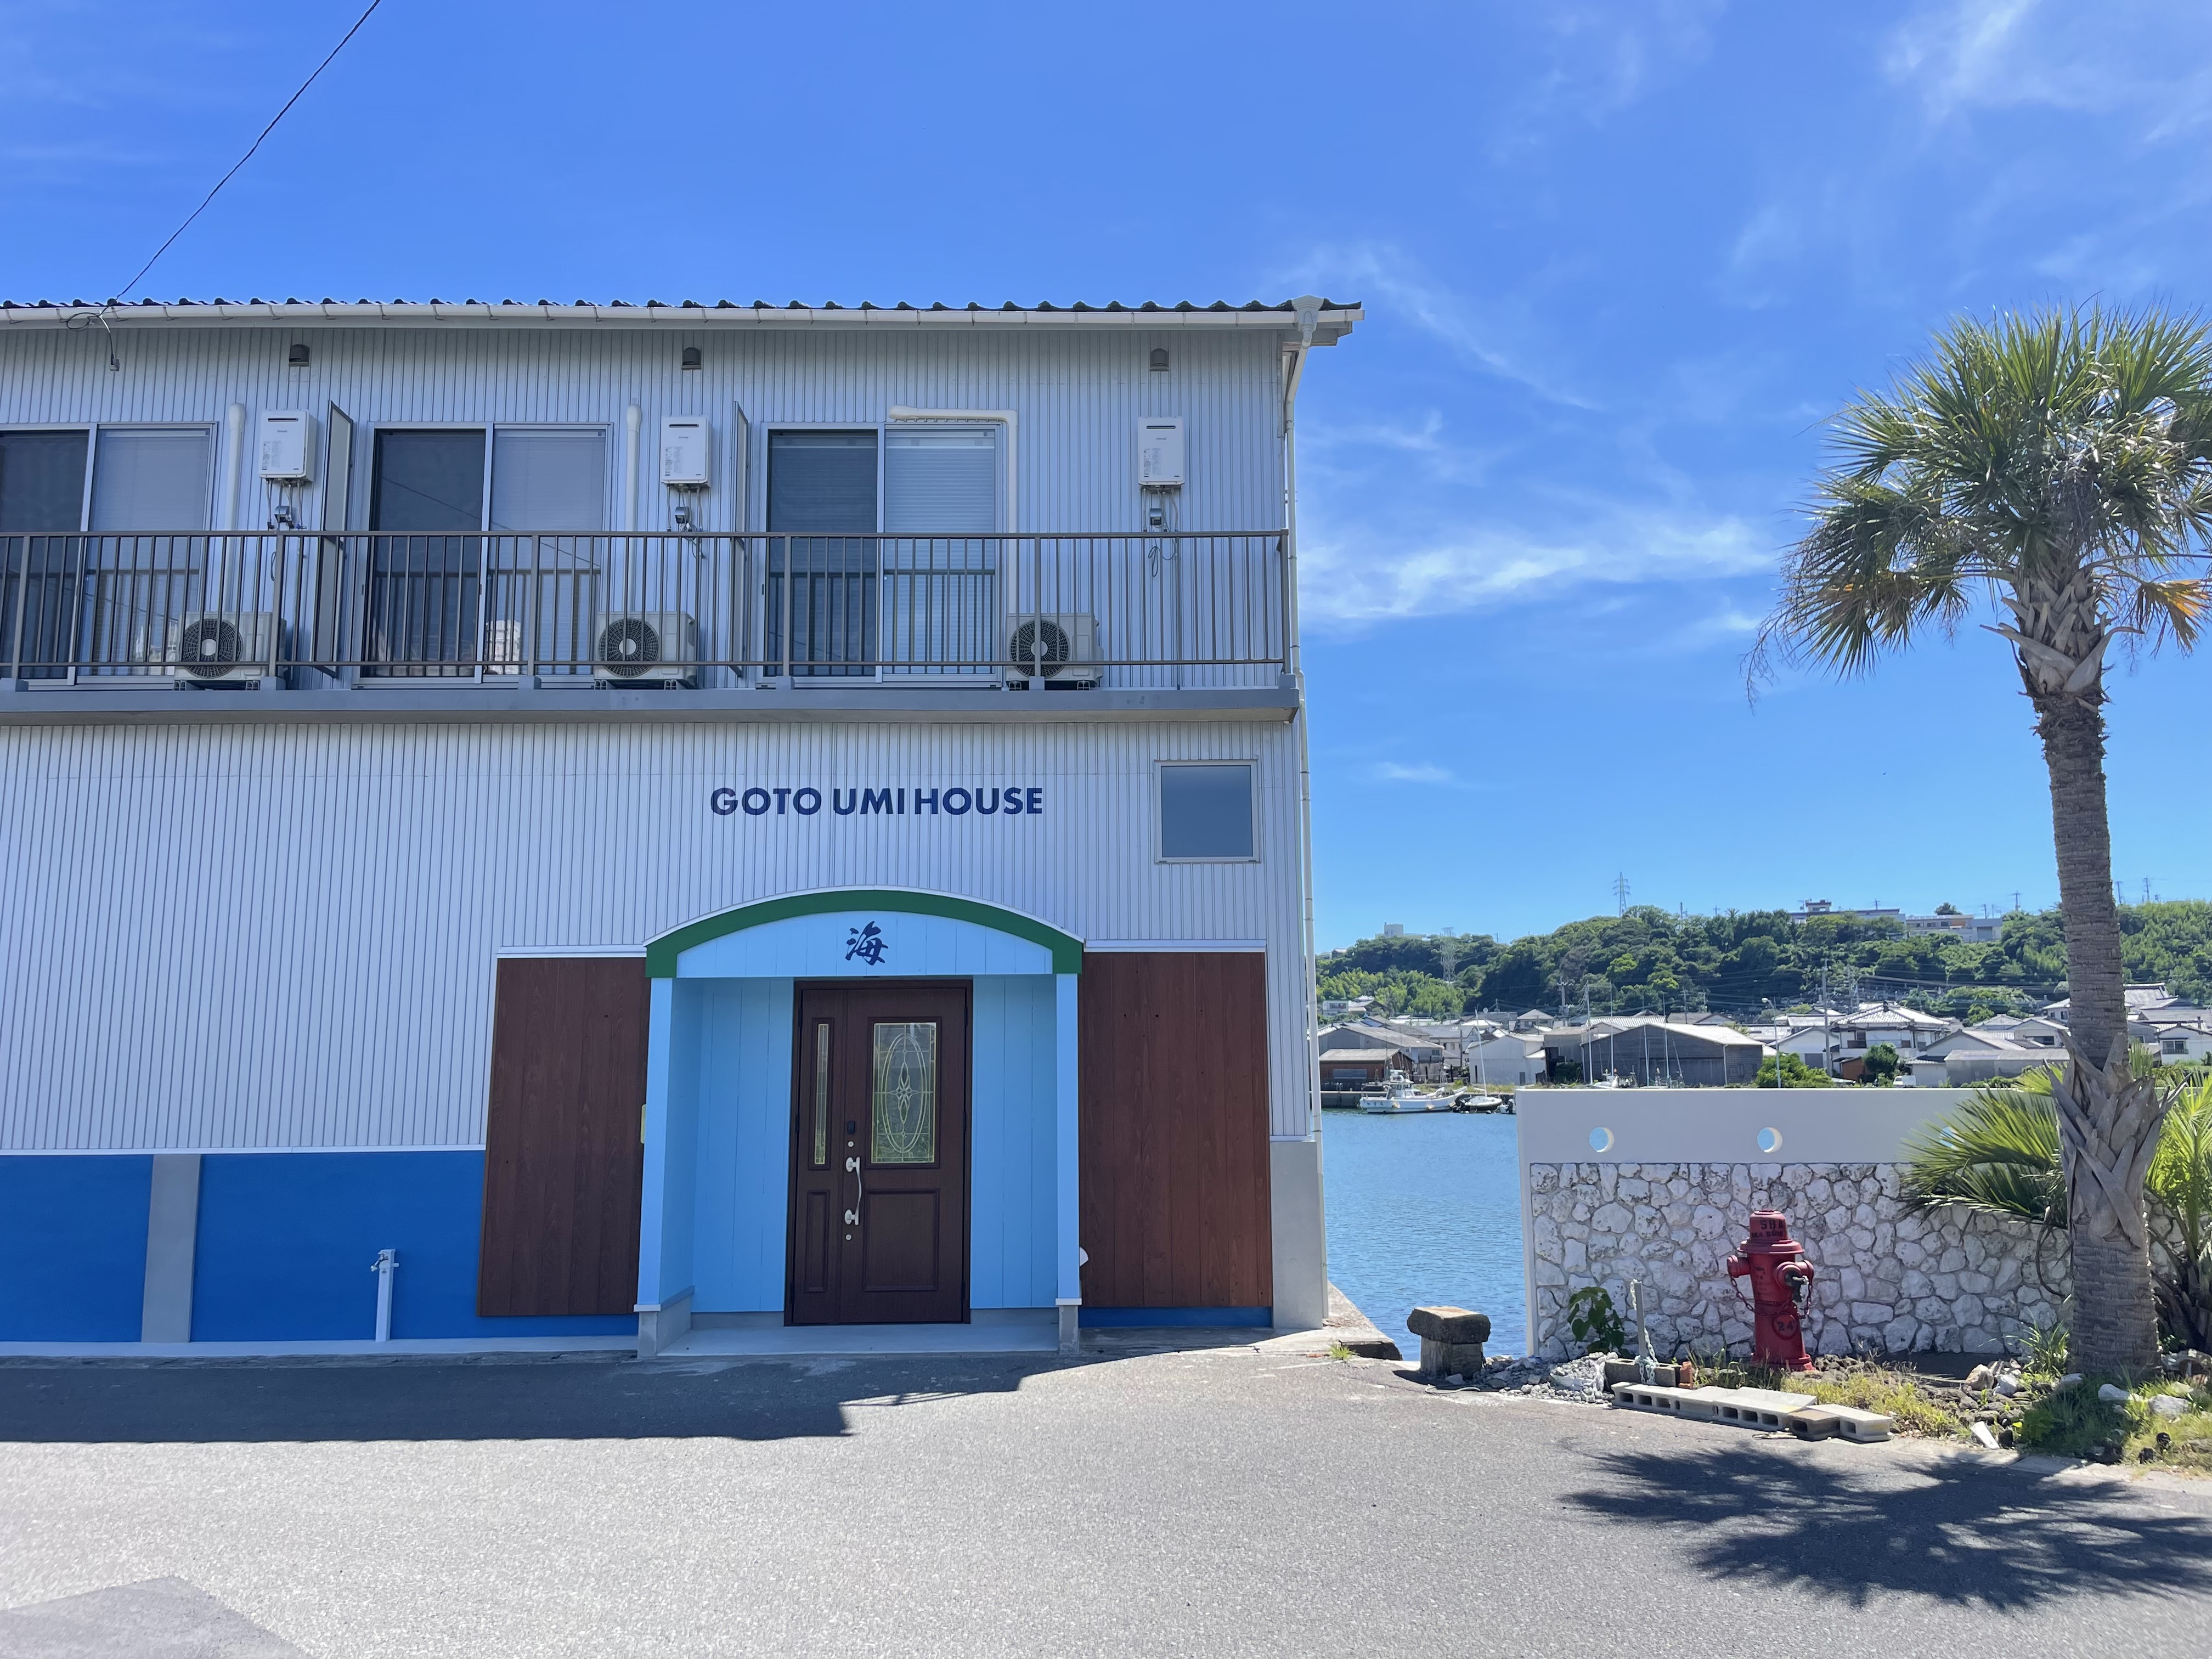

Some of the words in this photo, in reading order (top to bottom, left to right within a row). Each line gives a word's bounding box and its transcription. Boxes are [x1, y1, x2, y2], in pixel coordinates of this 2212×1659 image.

[710, 787, 822, 816] GOTO
[833, 787, 905, 815] UMI
[915, 787, 1043, 815] HOUSE
[845, 920, 889, 966] 海
[1778, 1321, 1793, 1331] 24
